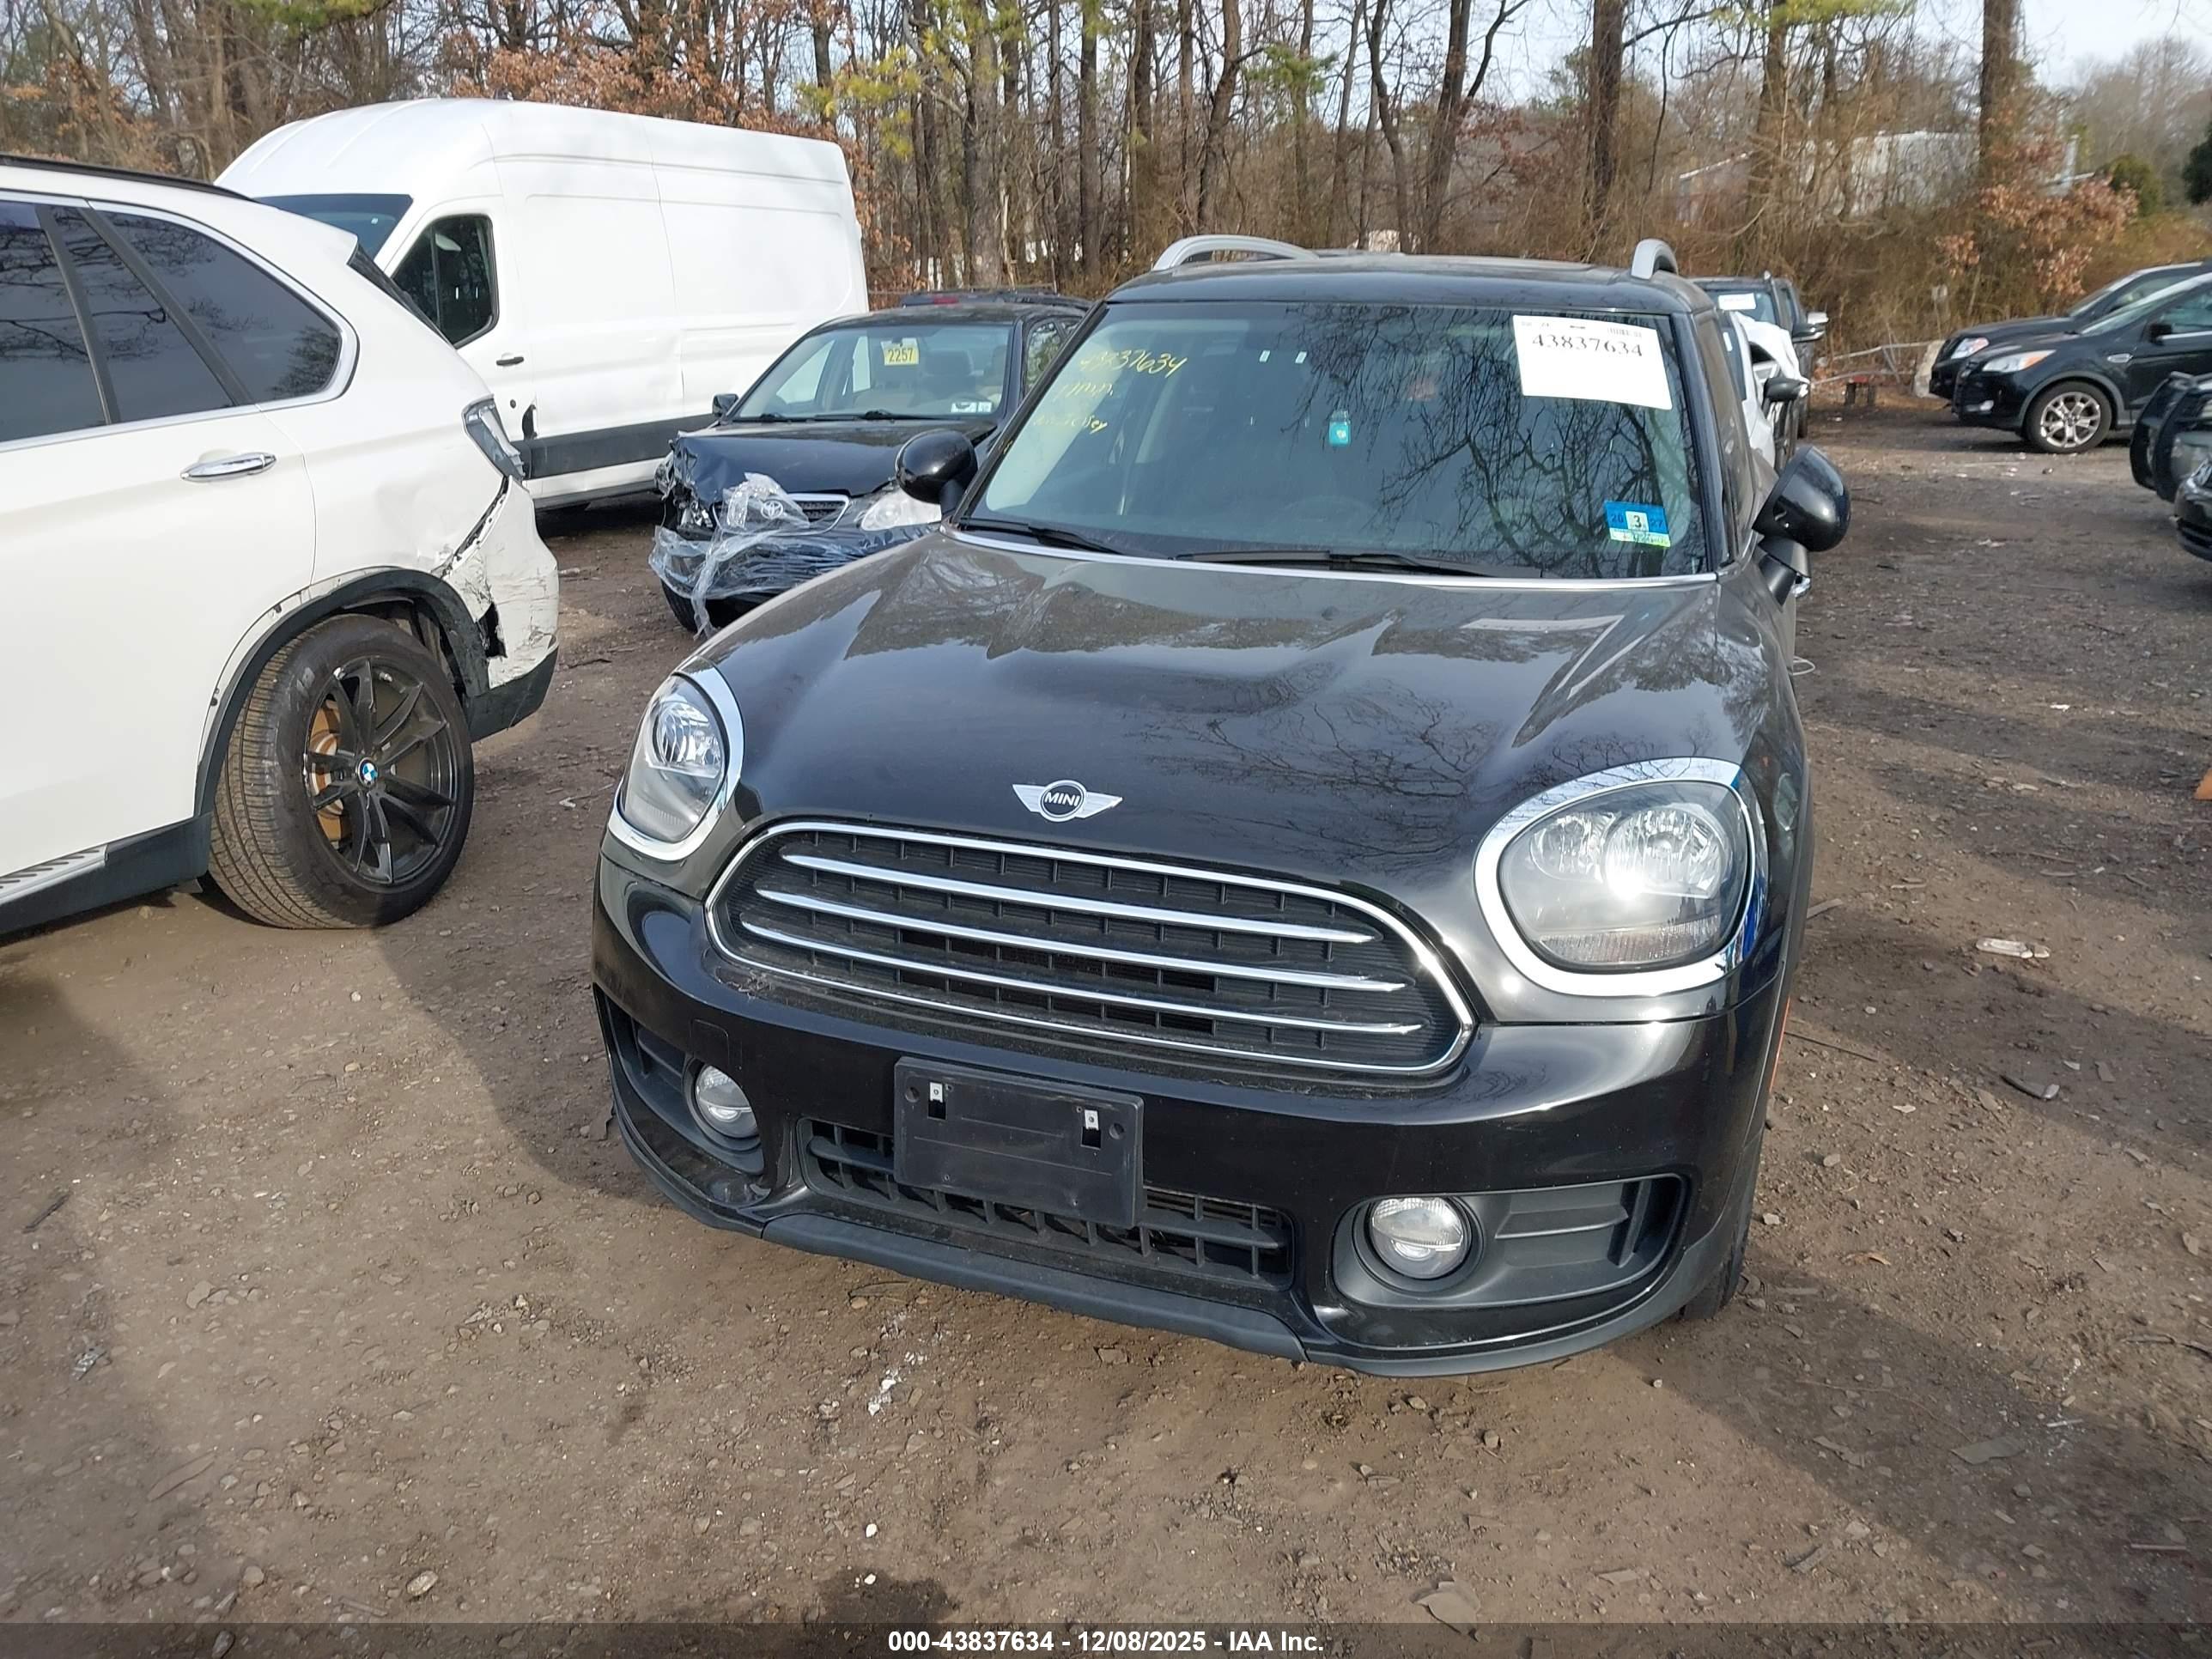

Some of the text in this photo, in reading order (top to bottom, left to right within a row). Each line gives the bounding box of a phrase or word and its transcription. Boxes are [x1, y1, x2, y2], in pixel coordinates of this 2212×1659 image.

[1533, 334, 1643, 356] 43837634
[888, 348, 914, 362] 2257
[1633, 514, 1643, 528] 3
[1044, 792, 1081, 807] MINI
